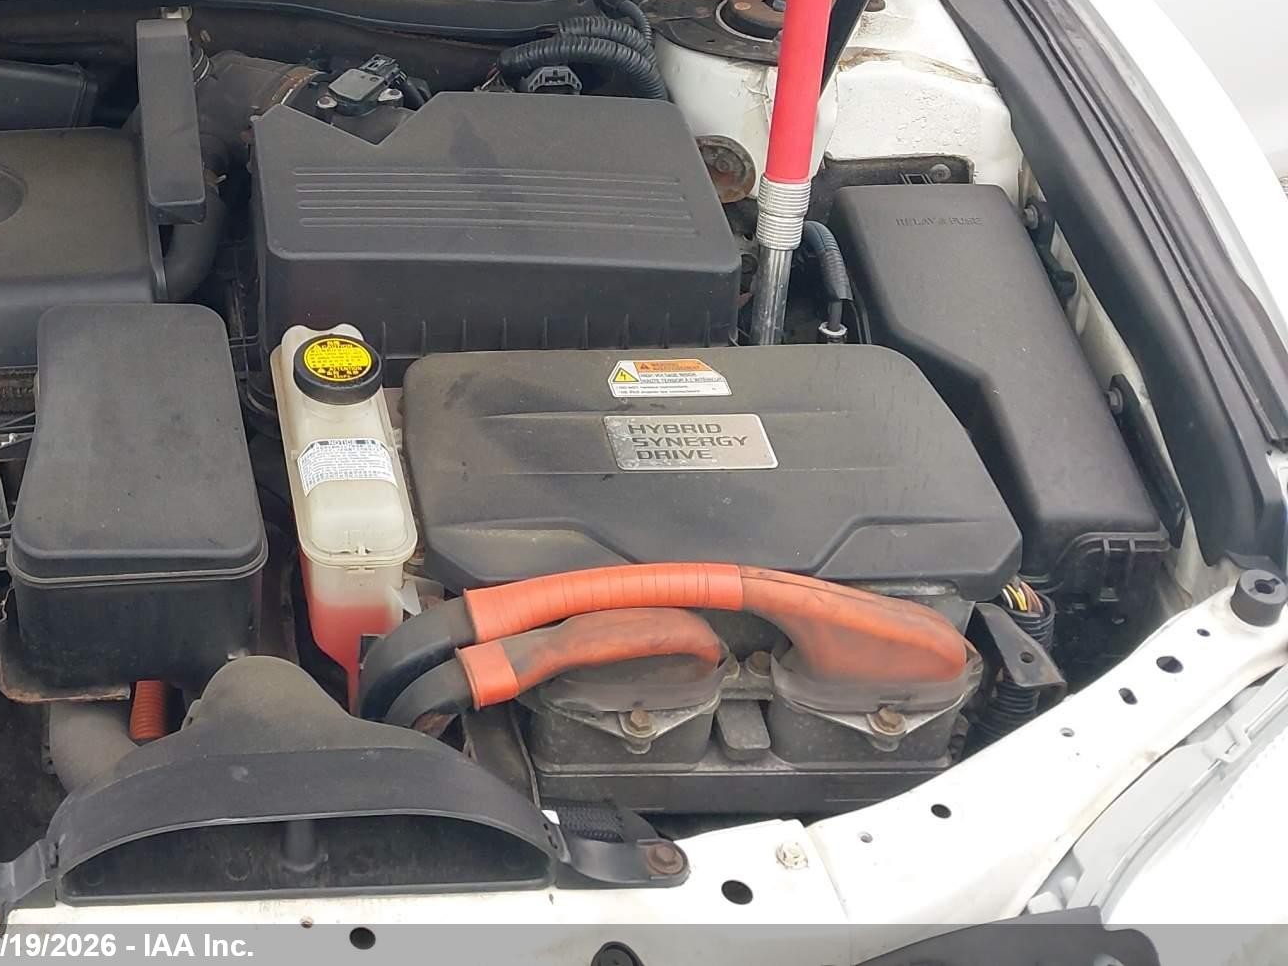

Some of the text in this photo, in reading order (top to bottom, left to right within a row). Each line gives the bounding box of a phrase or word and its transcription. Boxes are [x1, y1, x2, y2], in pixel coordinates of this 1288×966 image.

[627, 423, 723, 434] HYBRID
[631, 436, 748, 447] SYNERGY
[636, 449, 714, 460] DRIVE
